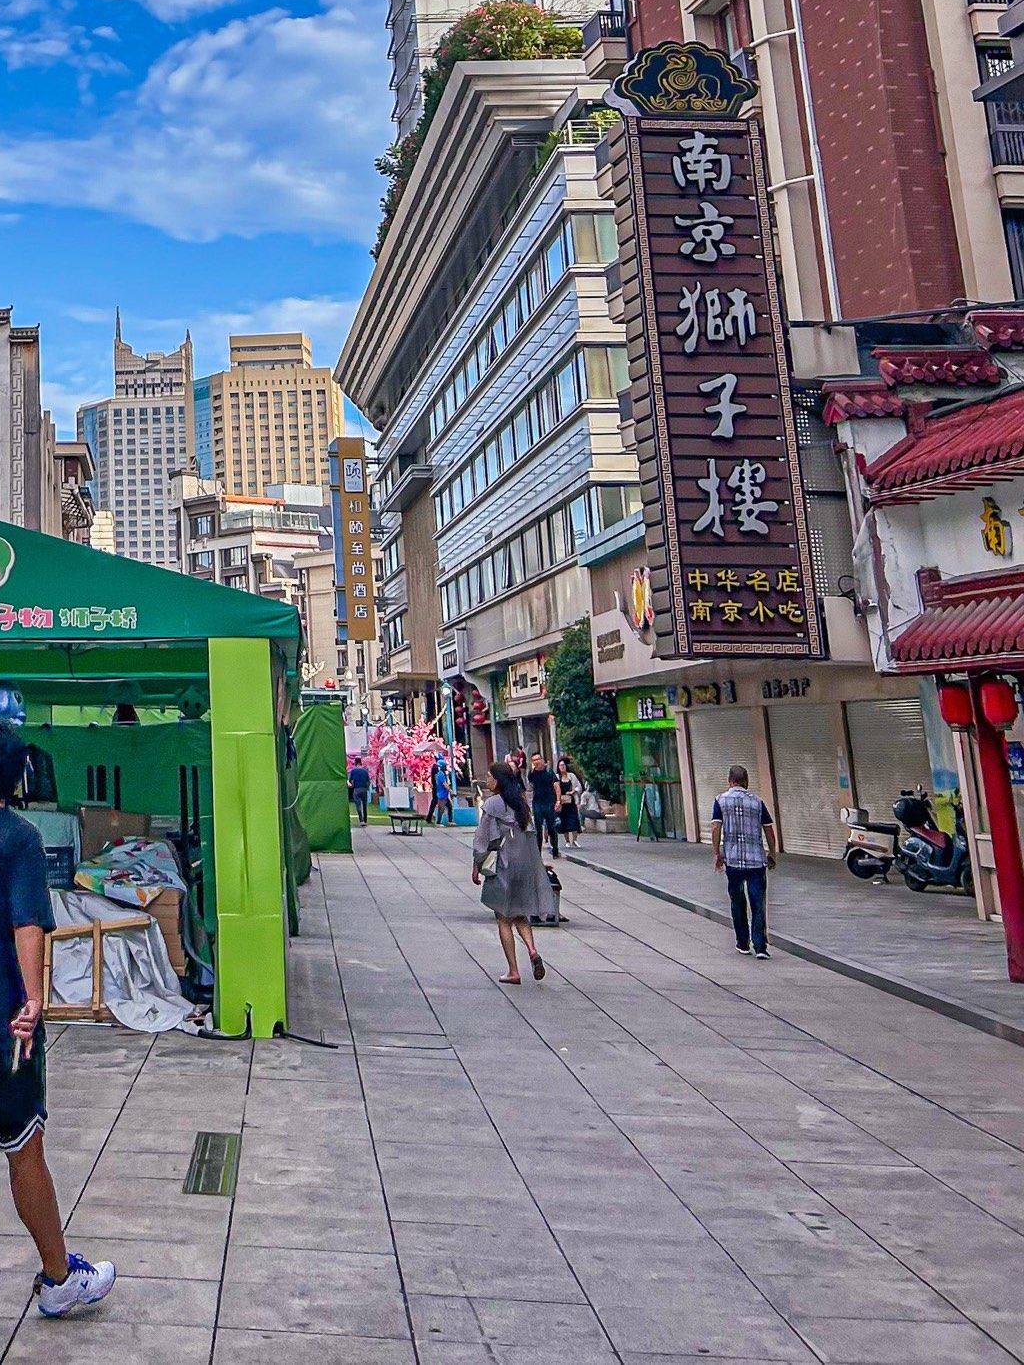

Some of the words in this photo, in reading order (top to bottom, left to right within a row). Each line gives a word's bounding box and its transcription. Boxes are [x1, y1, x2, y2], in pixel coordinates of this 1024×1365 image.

[348, 498, 368, 619] 和颐至尚酒店
[688, 568, 799, 593] 中华名店
[59, 606, 138, 631] 狮子桥
[689, 598, 804, 624] 南京小吃
